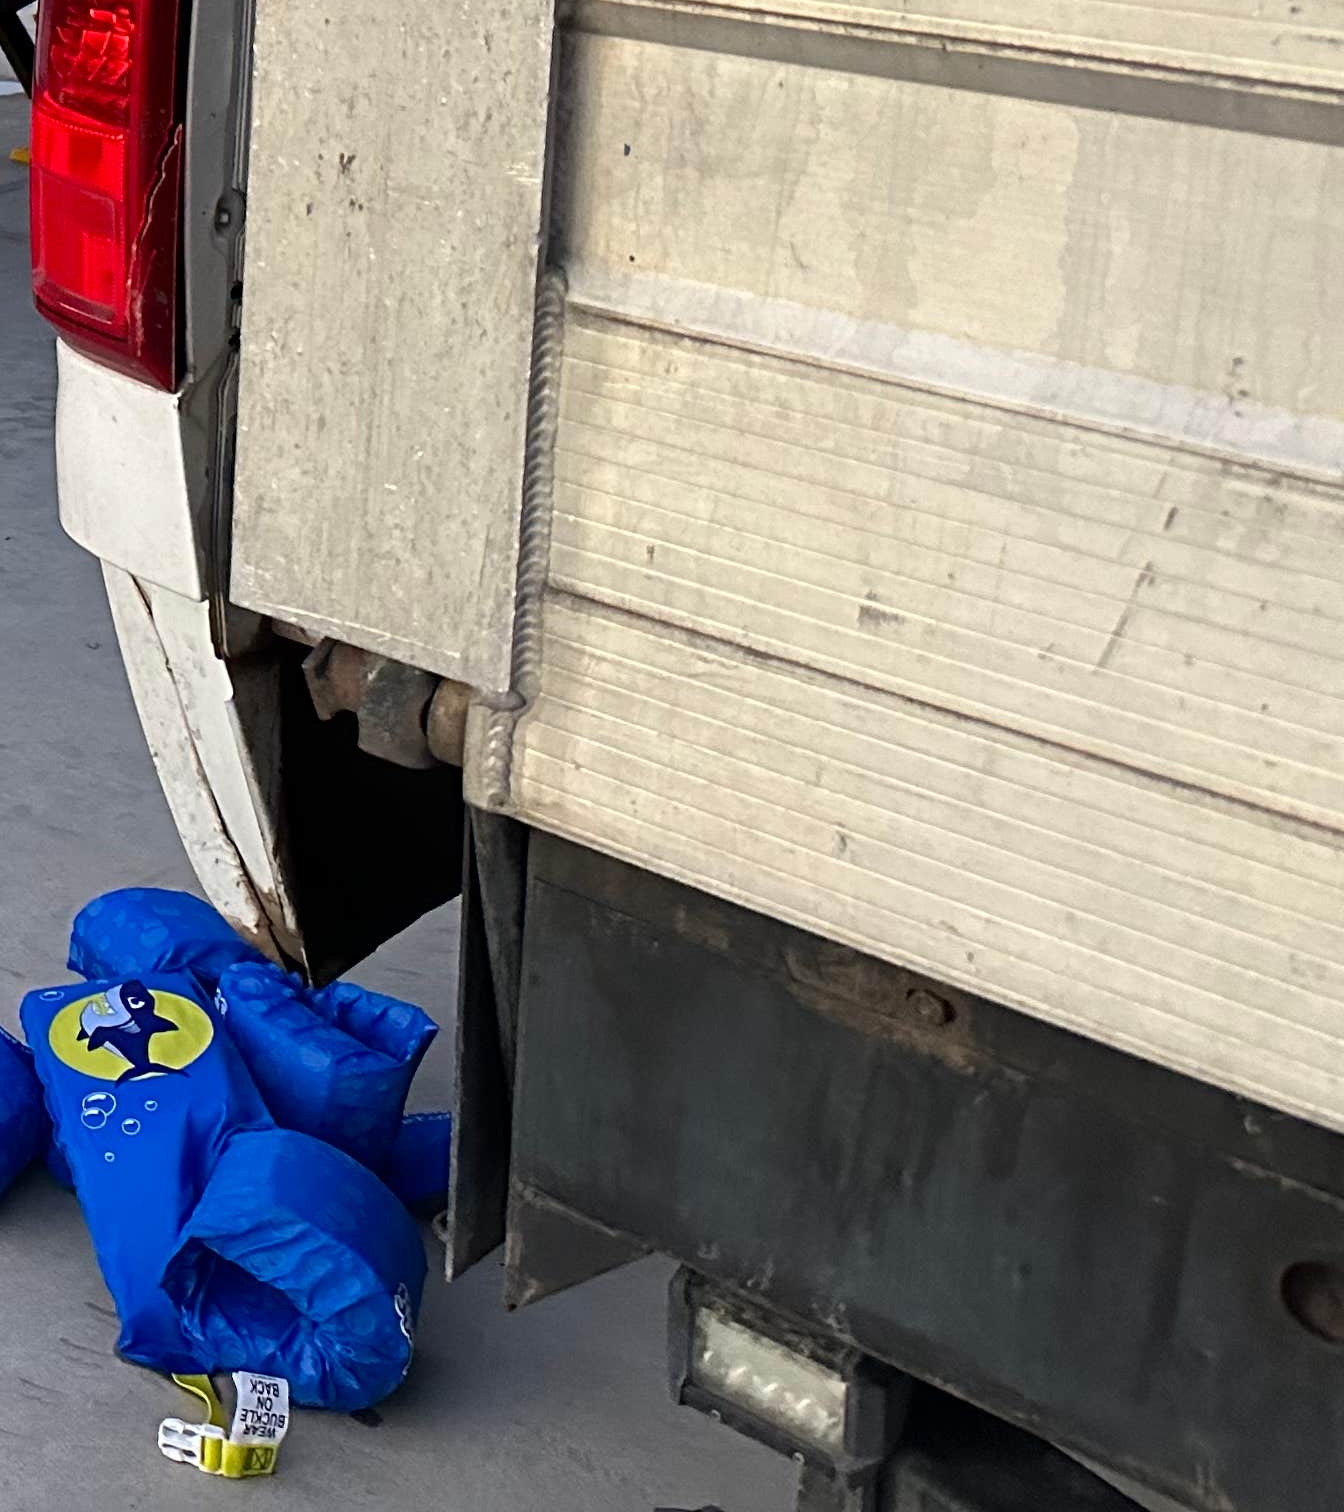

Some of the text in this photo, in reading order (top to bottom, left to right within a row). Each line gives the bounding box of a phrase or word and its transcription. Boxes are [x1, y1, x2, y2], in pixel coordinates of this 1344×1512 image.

[249, 1379, 279, 1397] BACK
[256, 1396, 273, 1411] ON
[240, 1409, 285, 1428] BUCKLE
[243, 1424, 276, 1438] WEAR
